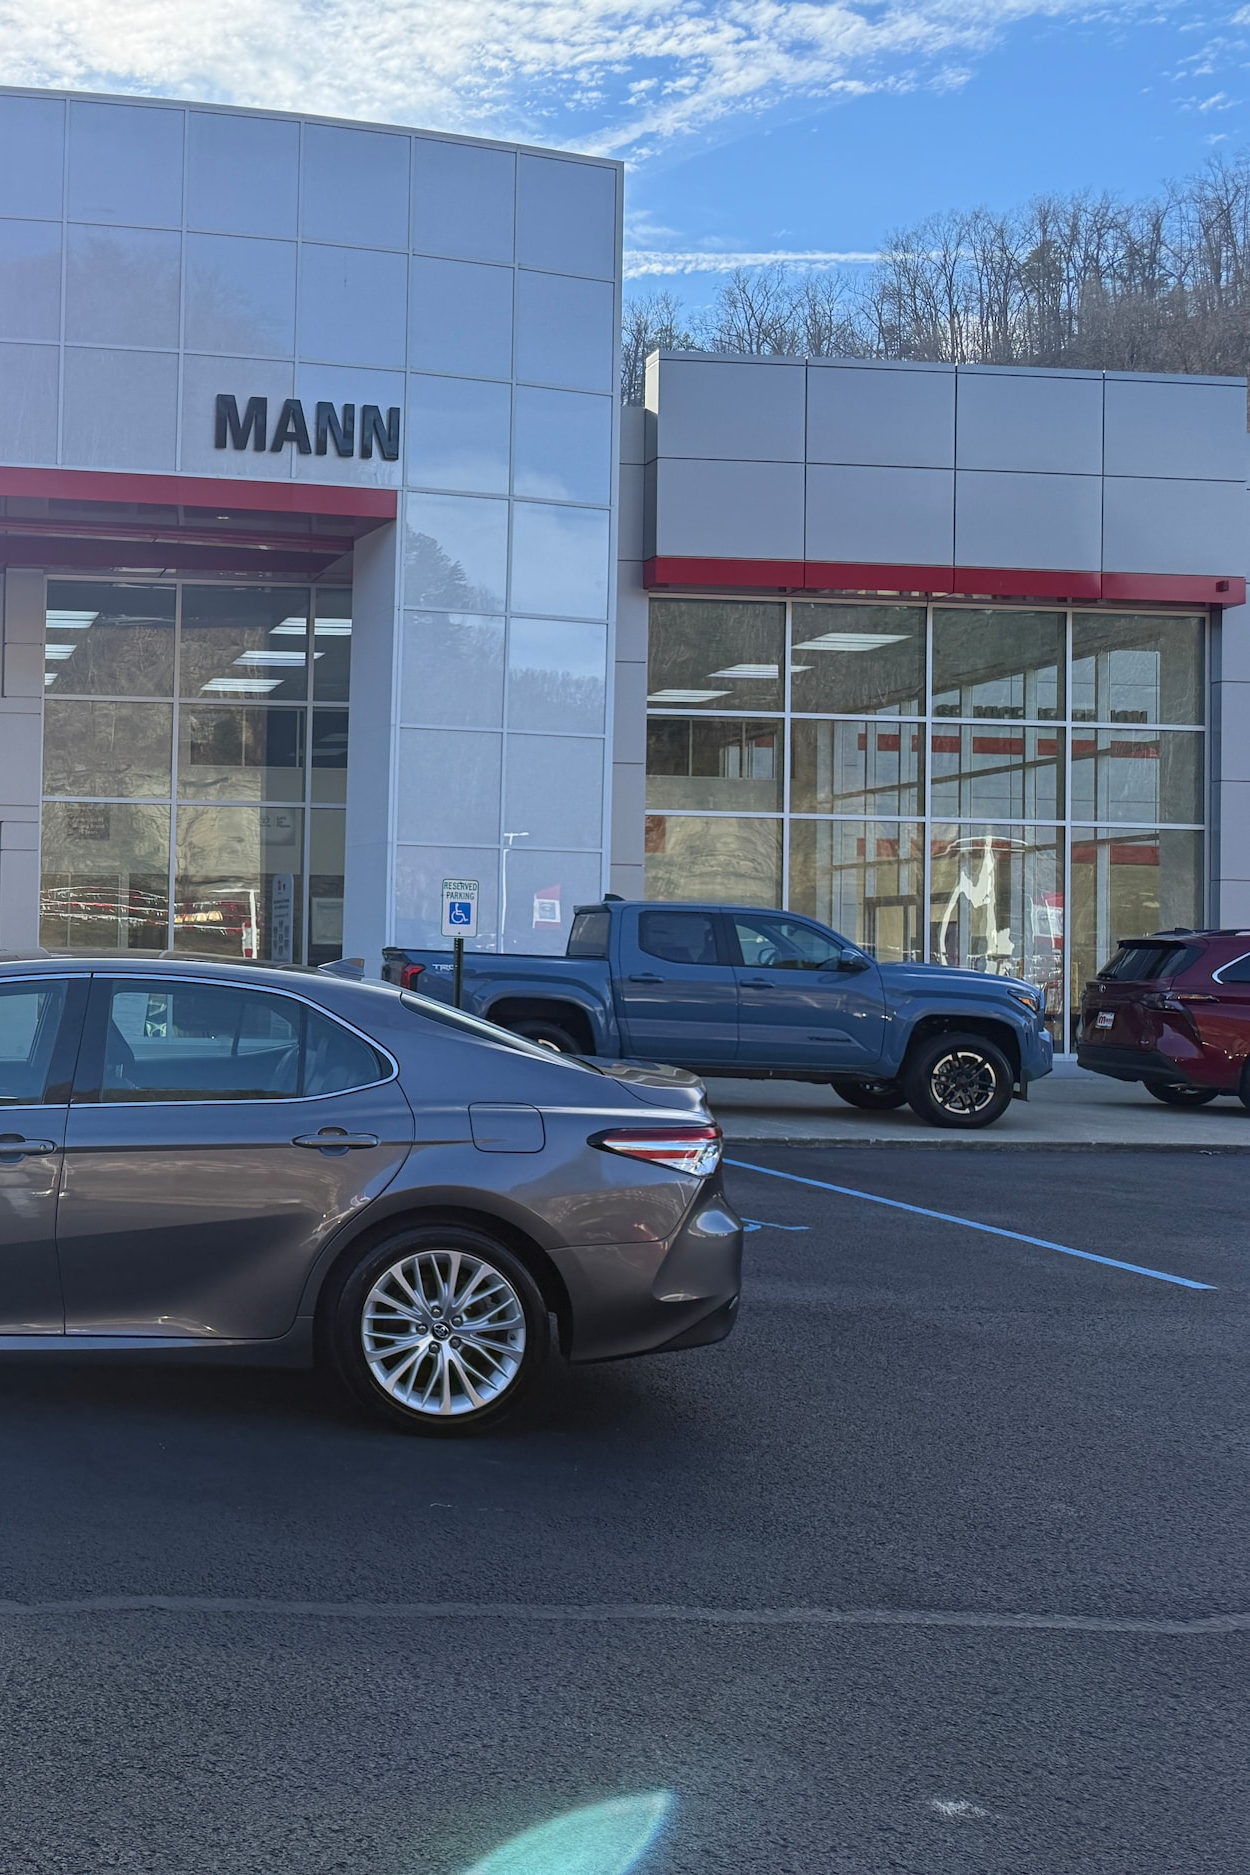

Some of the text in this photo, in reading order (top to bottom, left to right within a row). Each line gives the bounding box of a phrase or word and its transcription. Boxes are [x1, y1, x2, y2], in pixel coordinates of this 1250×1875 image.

[214, 393, 401, 462] MANN
[443, 881, 478, 891] RESERVED
[446, 891, 475, 901] PARKING
